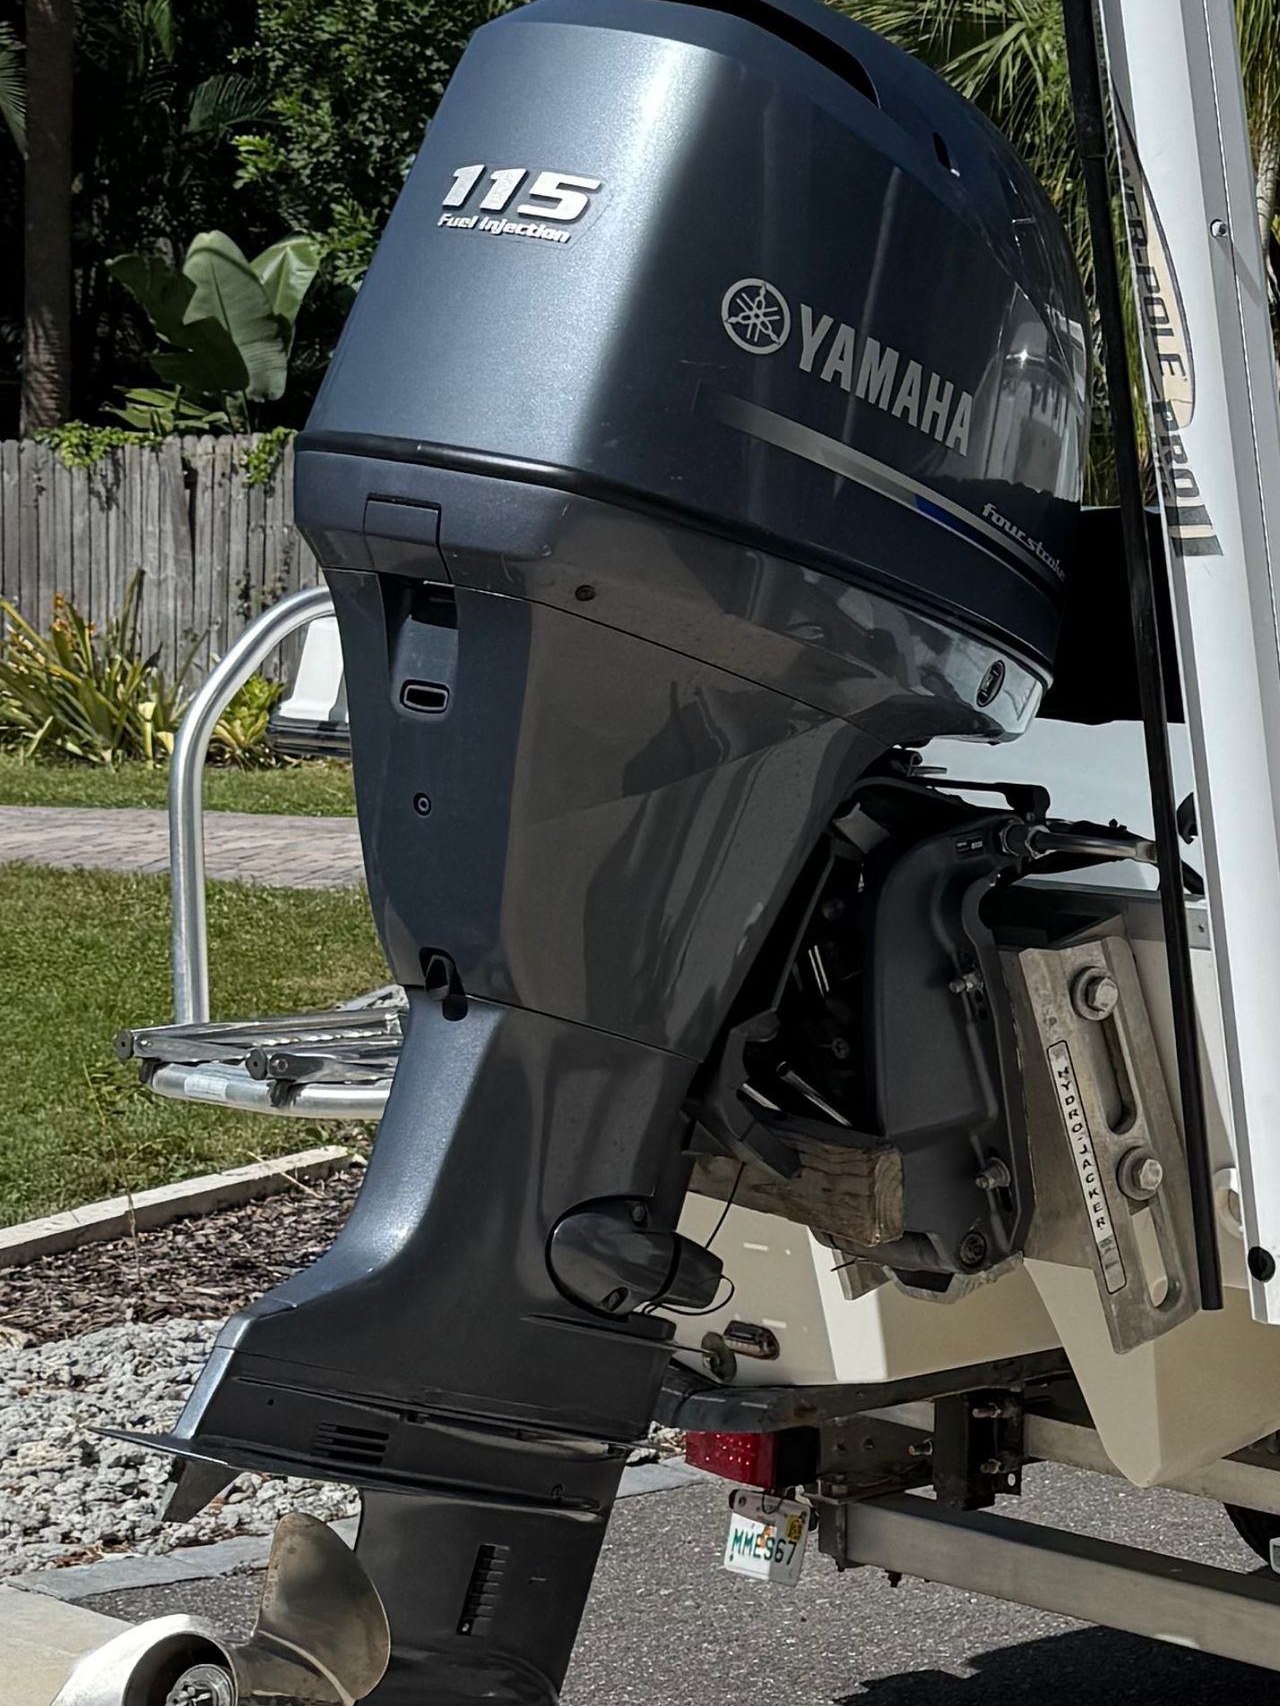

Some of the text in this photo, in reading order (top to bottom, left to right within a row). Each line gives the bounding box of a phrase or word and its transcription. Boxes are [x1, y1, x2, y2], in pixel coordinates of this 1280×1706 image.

[442, 164, 601, 222] 115
[437, 213, 572, 244] Fuel Injection
[799, 303, 973, 457] YAMAHA
